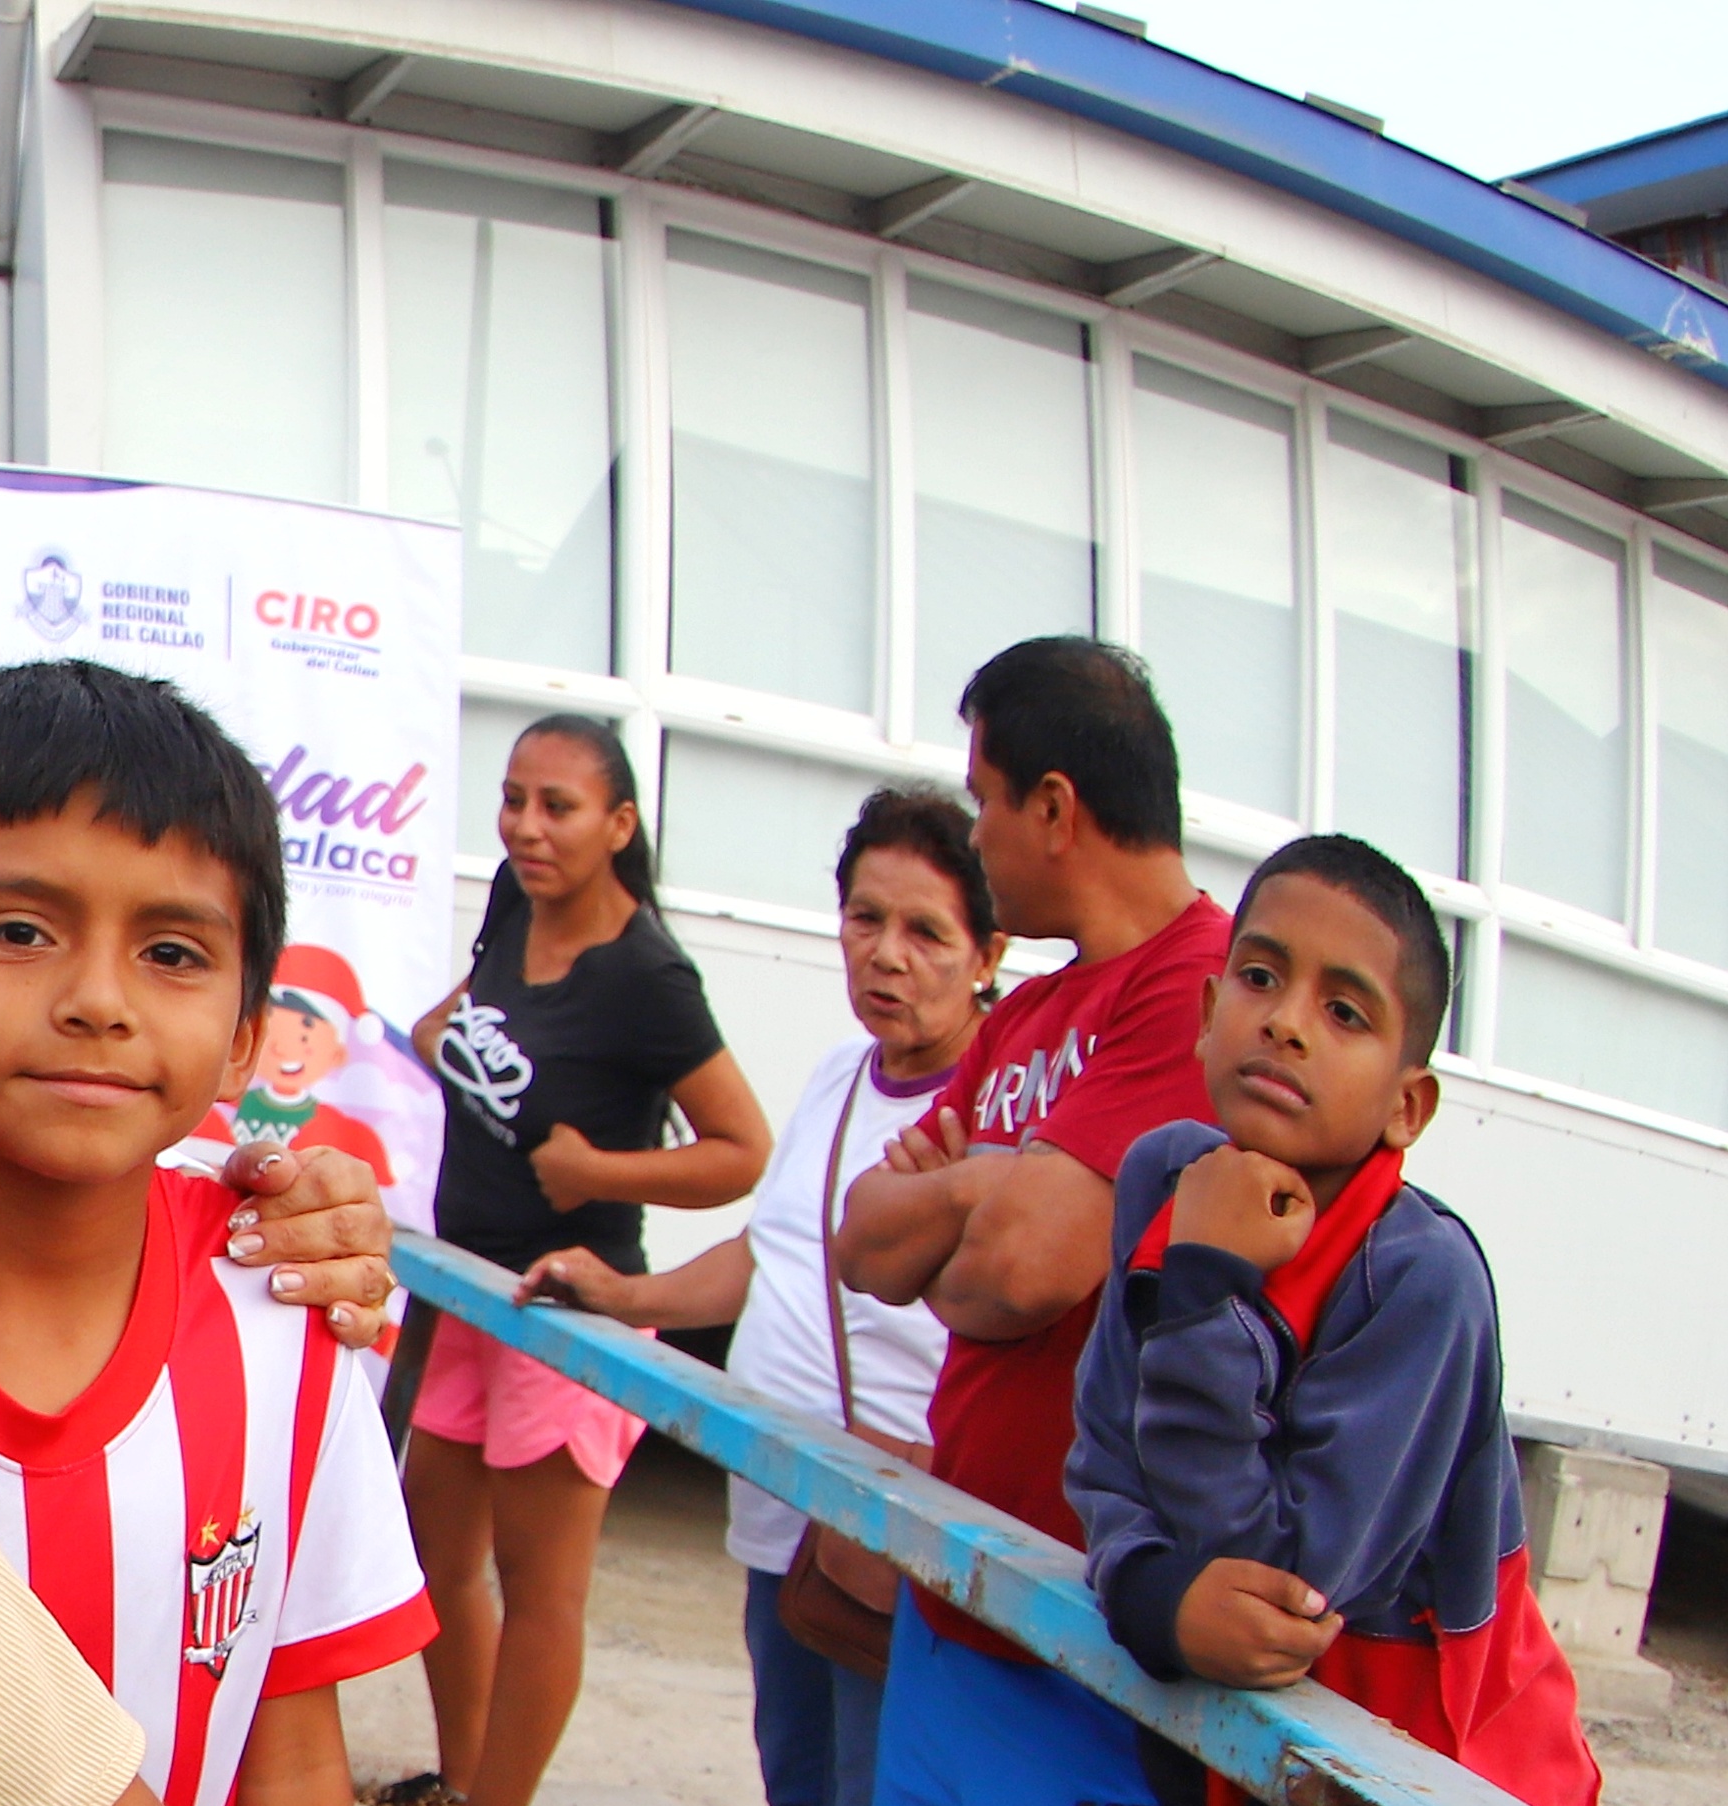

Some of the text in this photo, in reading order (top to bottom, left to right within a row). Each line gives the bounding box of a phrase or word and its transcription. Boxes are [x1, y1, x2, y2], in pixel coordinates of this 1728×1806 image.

[102, 581, 190, 606] GOBIERNO
[102, 602, 187, 627] REGIONAL
[254, 590, 381, 640] CIRO
[102, 623, 205, 649] DEL CALLAO
[270, 637, 360, 662] Gobernador
[306, 658, 380, 679] del Callao
